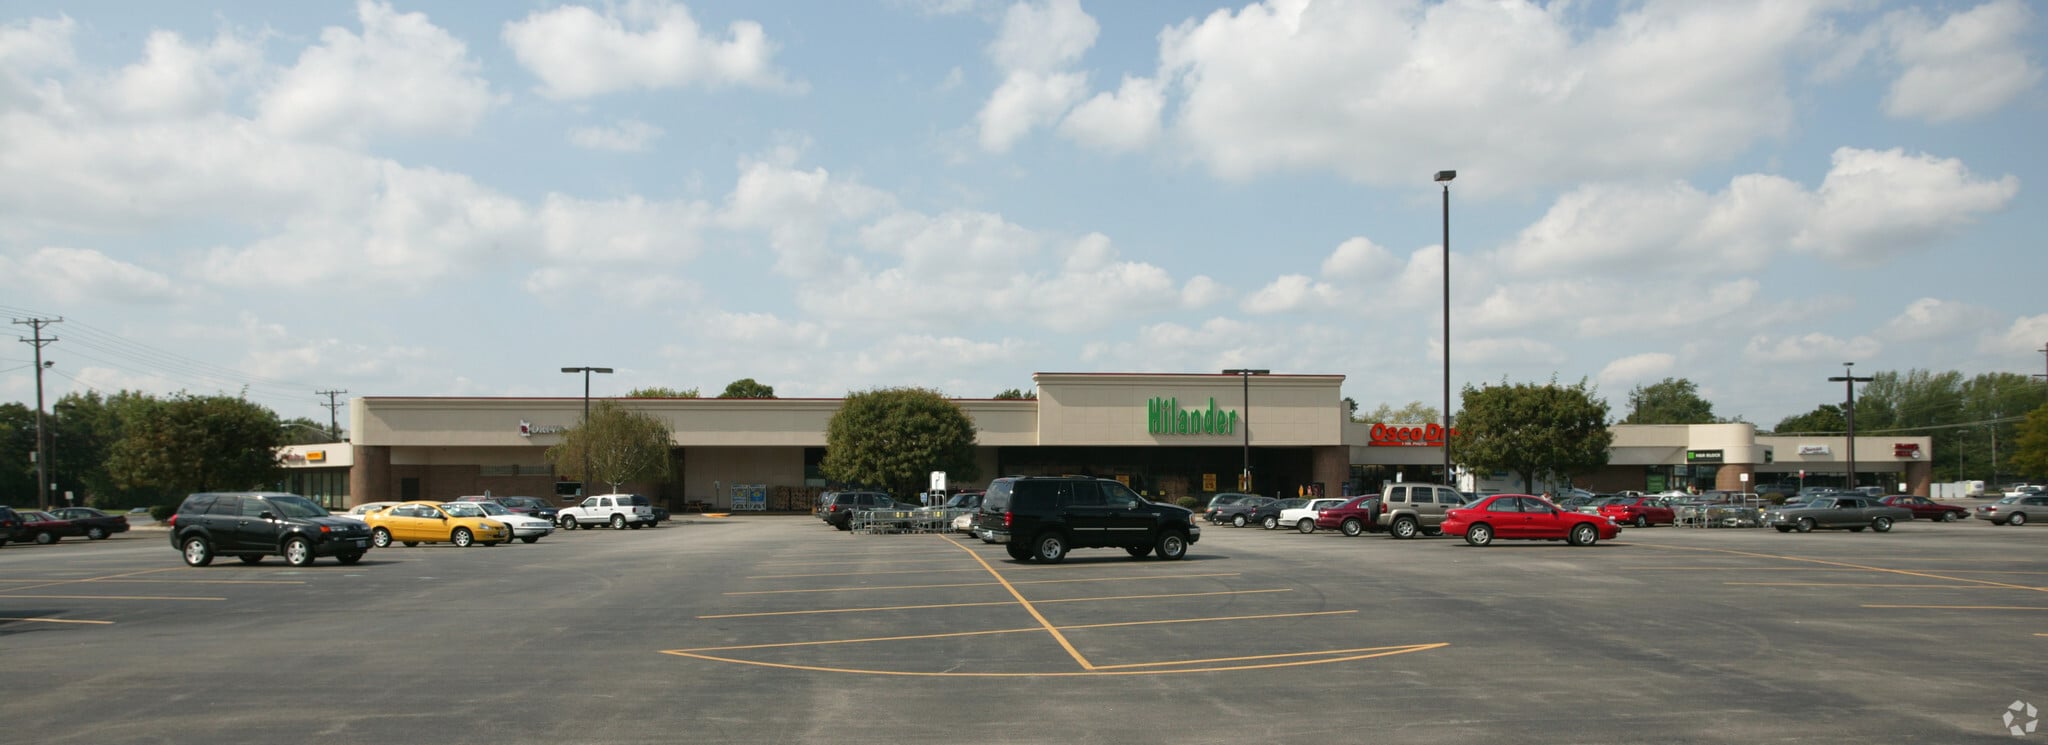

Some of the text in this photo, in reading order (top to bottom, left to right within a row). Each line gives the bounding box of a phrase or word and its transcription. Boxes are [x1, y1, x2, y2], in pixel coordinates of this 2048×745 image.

[1148, 397, 1236, 434] Hilander
[1370, 422, 1460, 441] Osco Dr
